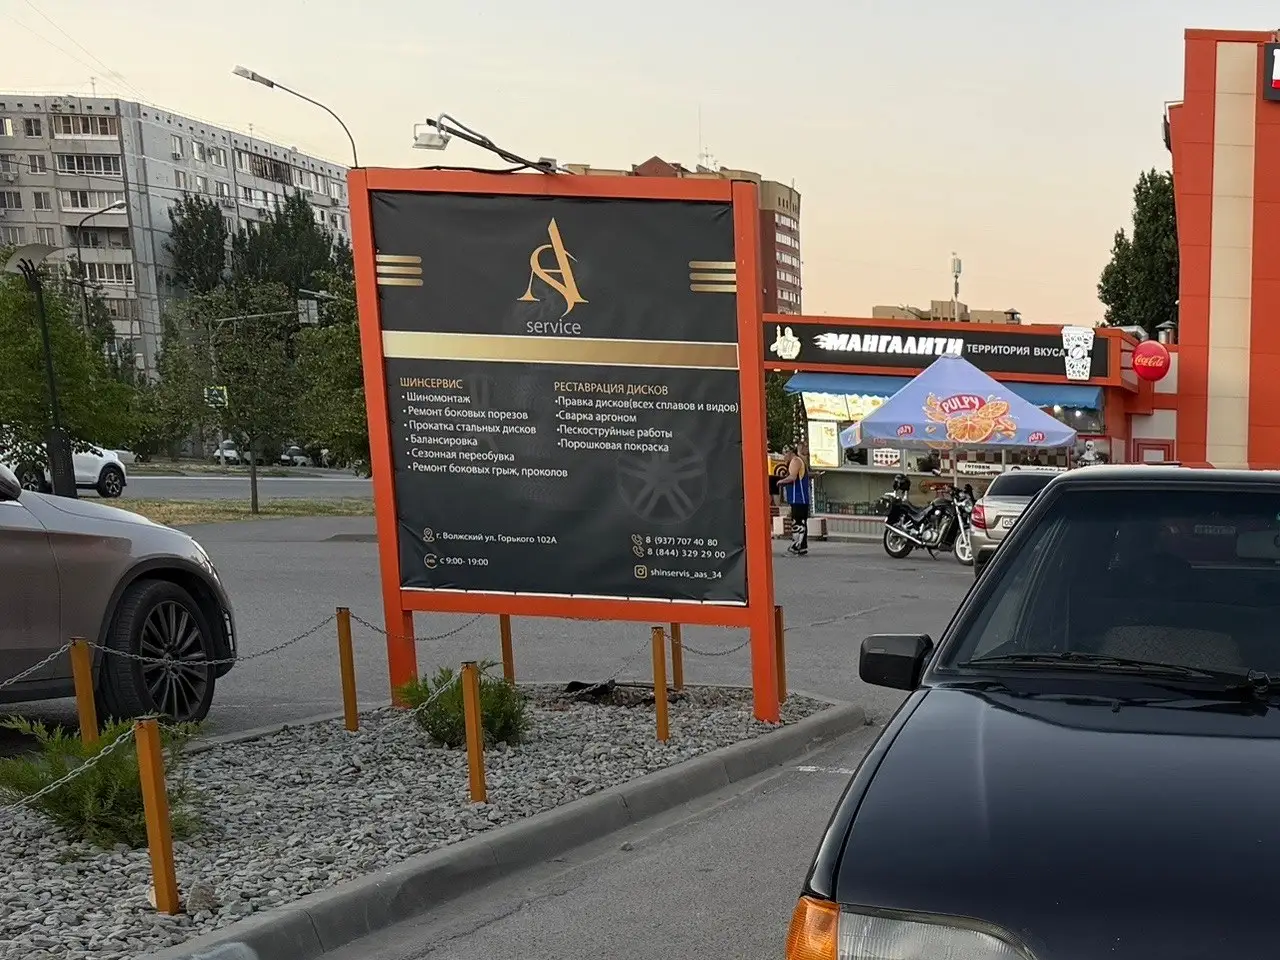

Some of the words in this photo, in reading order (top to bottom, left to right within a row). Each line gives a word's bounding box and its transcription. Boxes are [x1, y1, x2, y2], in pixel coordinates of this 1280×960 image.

[526, 319, 582, 335] service
[825, 332, 964, 355] МАНГАЛИТИ
[966, 343, 1031, 356] ТЕРРИТОРИЯ
[1033, 347, 1066, 358] ВКУСА
[400, 377, 463, 389] ШИНСЕРВИС
[554, 381, 625, 394] РЕСТАВРАЦИЯ
[626, 384, 669, 396] ДИСКОВ
[406, 392, 471, 404] Шиномонтаж
[558, 396, 593, 408] Правка
[656, 402, 696, 410] сплавов
[706, 403, 739, 413] видов)
[942, 395, 980, 413] PULPY
[408, 406, 442, 417] Ремонт
[444, 407, 486, 418] боковых
[488, 410, 529, 421] порезов
[558, 410, 594, 422] Сварка
[595, 414, 637, 424] аргоном
[409, 420, 454, 432] Прокатка
[456, 424, 500, 433] стальных
[502, 426, 537, 436] дисков
[559, 424, 635, 438] Пескоструйные
[637, 427, 673, 439] работы
[410, 434, 478, 447] Балансировка
[560, 438, 622, 451] Порошковая
[624, 442, 670, 453] покраска
[411, 448, 456, 459] Сезонная
[459, 451, 515, 463] переобувка
[413, 462, 447, 472] Ремонт
[449, 463, 490, 474] боковых
[492, 466, 520, 476] грыж,
[521, 468, 568, 478] проколов
[442, 532, 484, 540] Волжский
[484, 534, 497, 543] ул.
[497, 534, 535, 544] Горького
[645, 536, 651, 544] 8
[654, 536, 675, 545] (937)
[676, 538, 692, 546] 707
[693, 538, 704, 546] 40
[655, 548, 679, 557] (844)
[682, 549, 698, 557] 329
[700, 550, 712, 558] 29
[468, 558, 489, 566] 19:00
